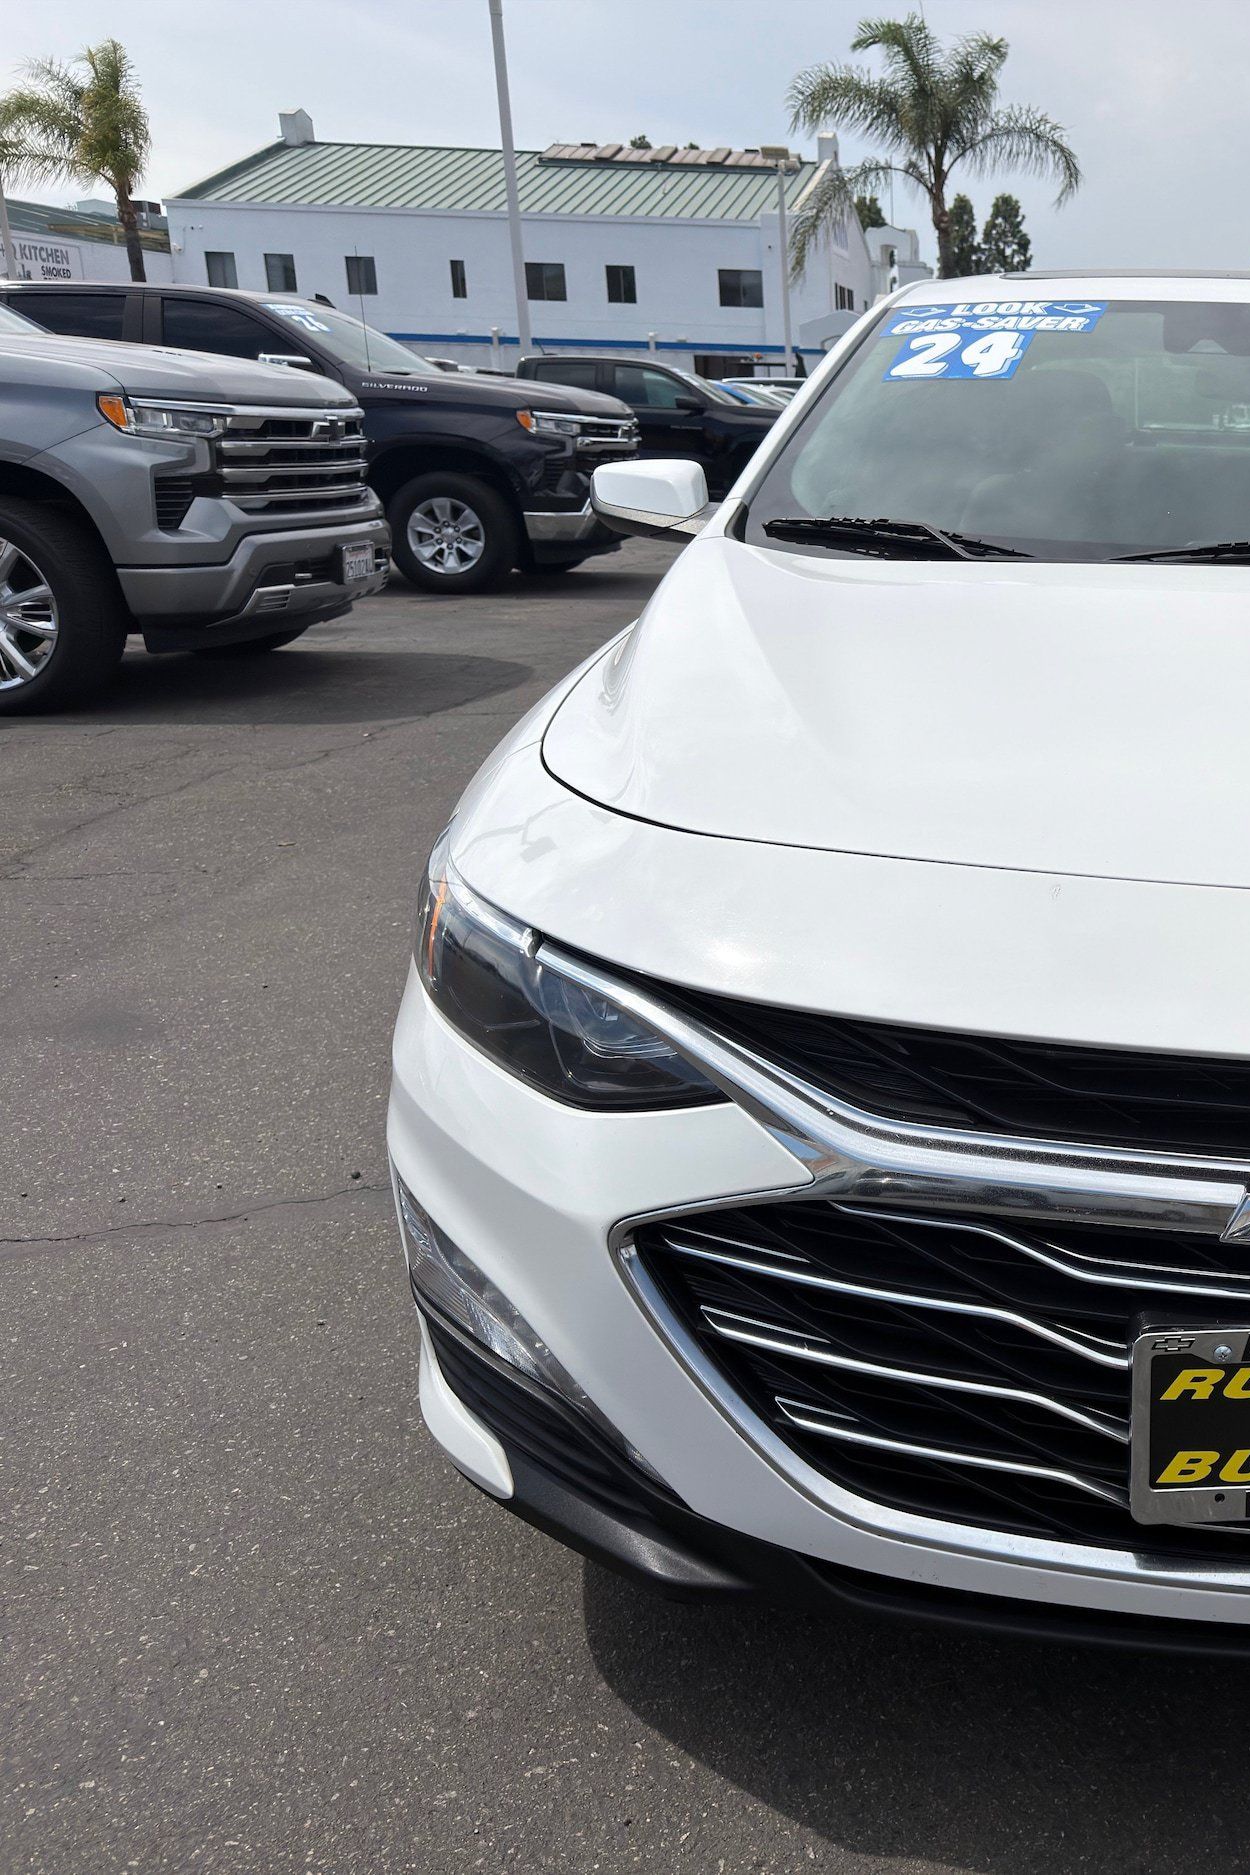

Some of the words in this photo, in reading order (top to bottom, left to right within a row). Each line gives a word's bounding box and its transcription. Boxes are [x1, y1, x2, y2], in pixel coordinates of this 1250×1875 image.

[19, 243, 70, 265] KITCHEN
[41, 265, 71, 279] SMOKED
[950, 302, 1053, 316] LOOK
[890, 331, 1024, 377] 24
[361, 382, 428, 393] SILVERADO
